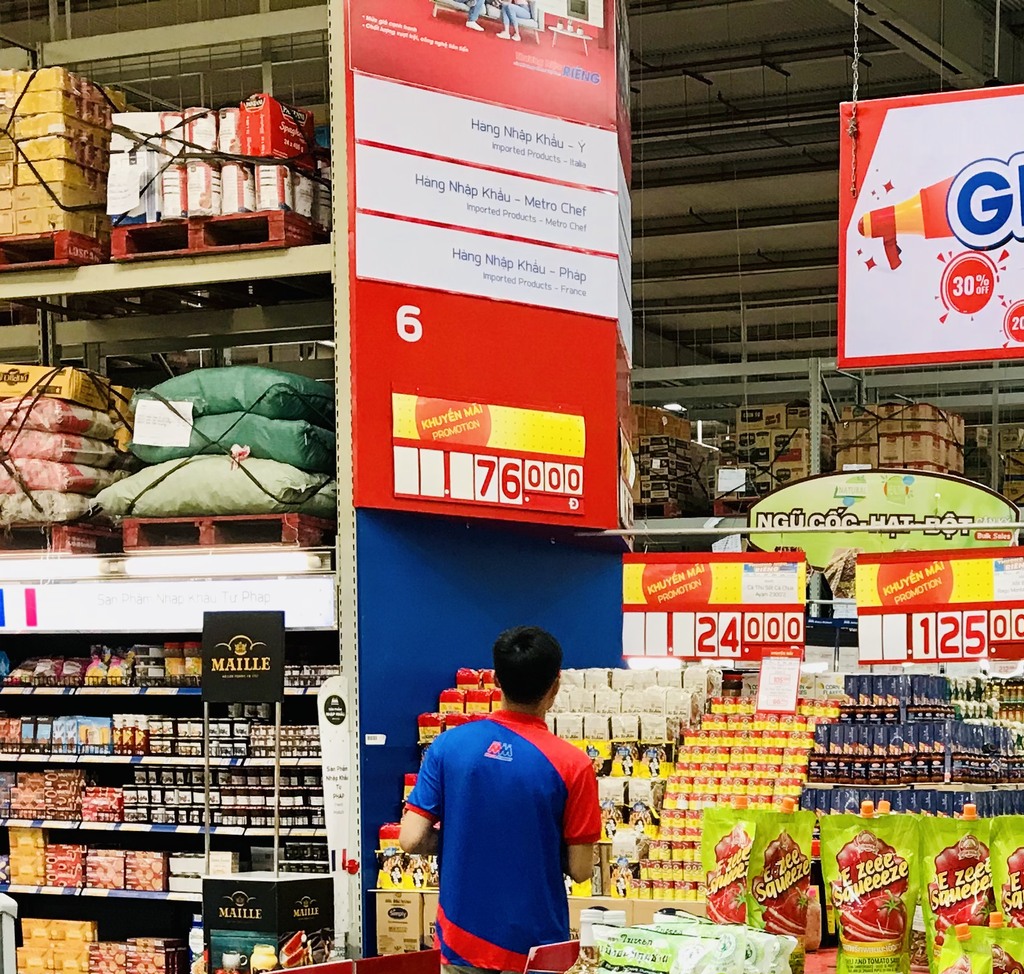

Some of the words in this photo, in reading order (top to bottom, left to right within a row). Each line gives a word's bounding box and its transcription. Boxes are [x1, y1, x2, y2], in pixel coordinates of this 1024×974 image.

[492, 142, 525, 157] Imported
[527, 150, 560, 164] Products
[570, 157, 586, 168] Italia
[467, 203, 500, 216] Imported
[503, 209, 536, 222] Products
[546, 218, 567, 228] Metro
[570, 222, 587, 232] Chef
[525, 196, 557, 211] Metro
[561, 203, 587, 217] Chef
[483, 272, 516, 285] Imported
[519, 278, 552, 291] Products
[561, 284, 586, 296] France
[976, 286, 989, 295] OFF
[396, 305, 422, 342] 6
[421, 409, 462, 430] KHUYẾN
[464, 404, 483, 418] MÃI
[432, 420, 480, 440] PROMOTION
[977, 532, 992, 540] Bulk
[993, 532, 1011, 540] Sales
[647, 569, 685, 595] KHUYẾN
[687, 563, 705, 579] MÃI
[657, 579, 702, 604] PROMOTION
[882, 571, 924, 597] KHUYẾN
[925, 561, 945, 579] MÃI
[894, 577, 942, 604] PROMOTION
[211, 657, 271, 672] MAILLE
[857, 852, 894, 877] zeee
[218, 906, 262, 919] MAILLE
[293, 907, 319, 918] MAILLE
